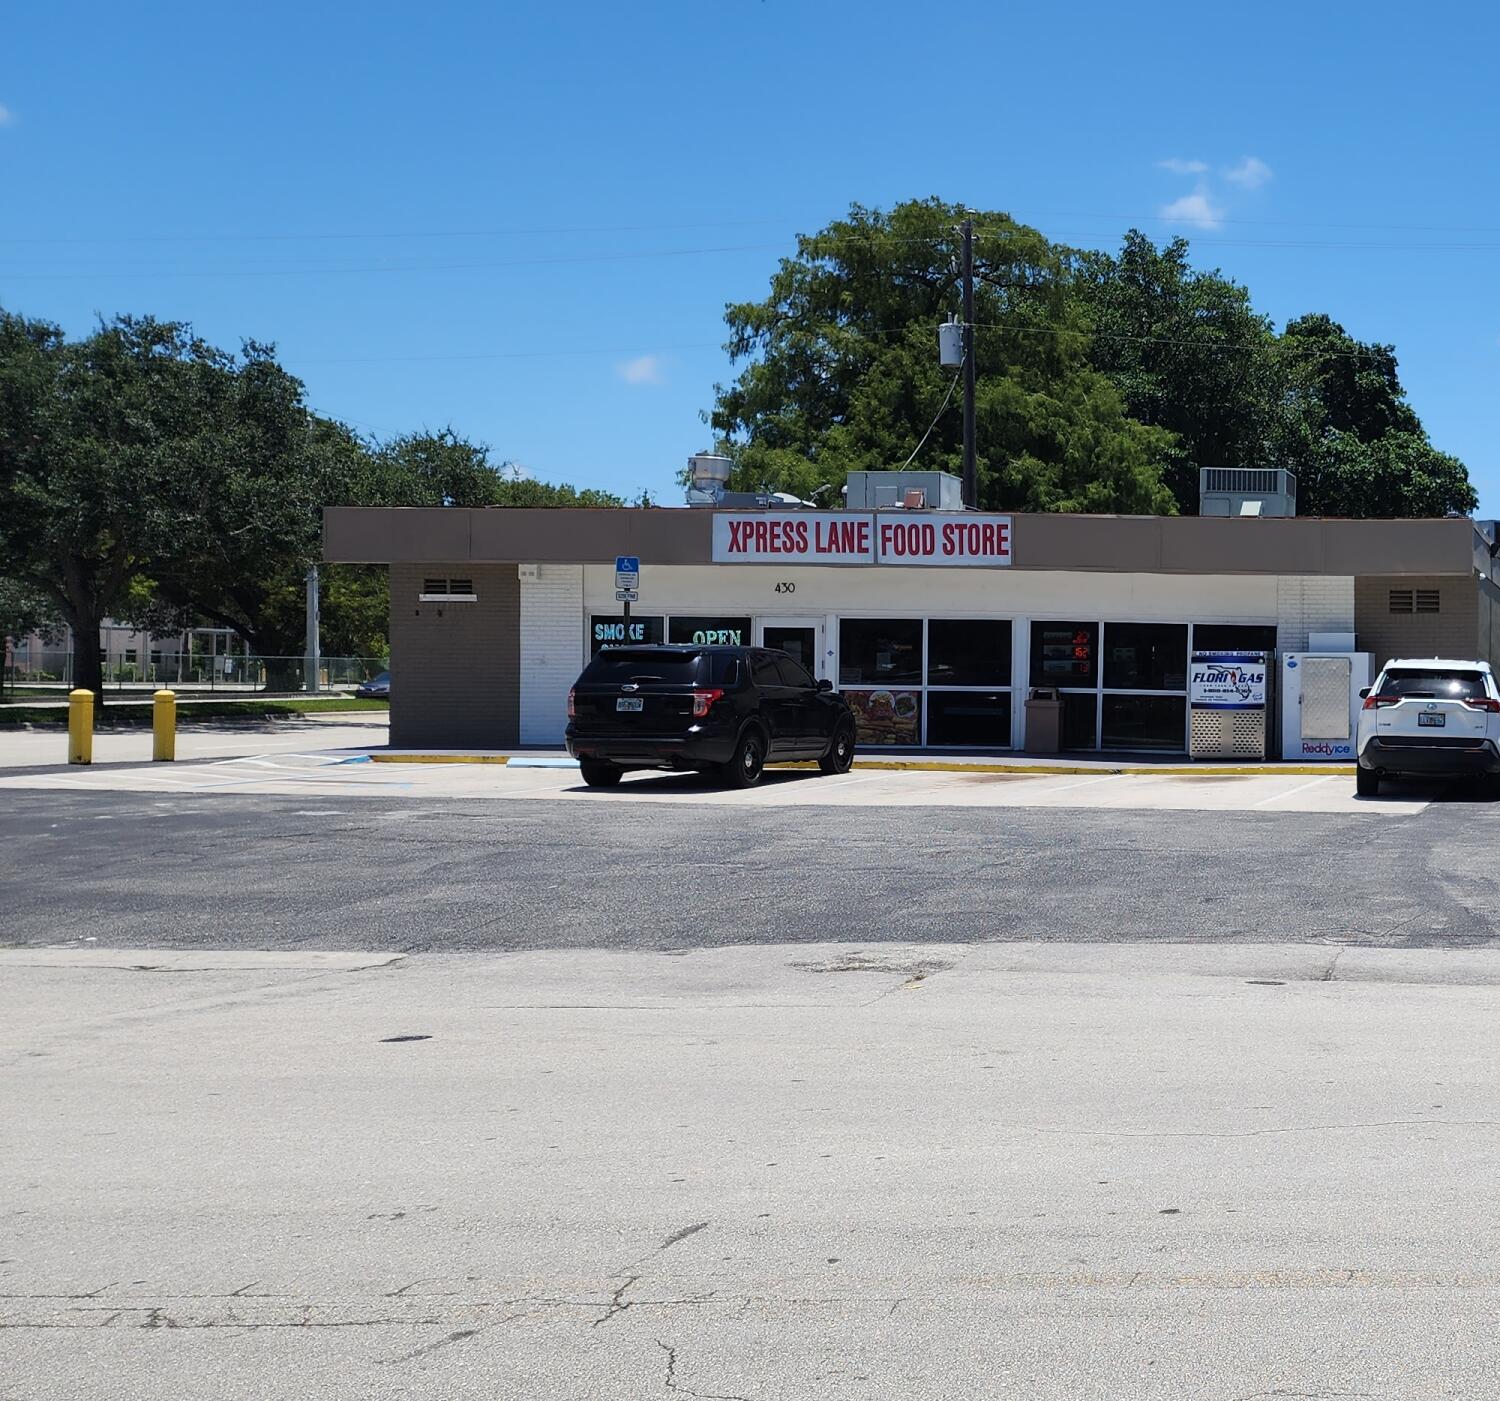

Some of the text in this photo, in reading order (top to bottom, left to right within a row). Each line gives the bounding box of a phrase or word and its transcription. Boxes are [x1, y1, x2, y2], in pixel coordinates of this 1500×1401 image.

[728, 521, 1009, 556] XPRESS LANE FOOD STORE
[775, 582, 796, 594] 430
[693, 630, 741, 646] OPEN
